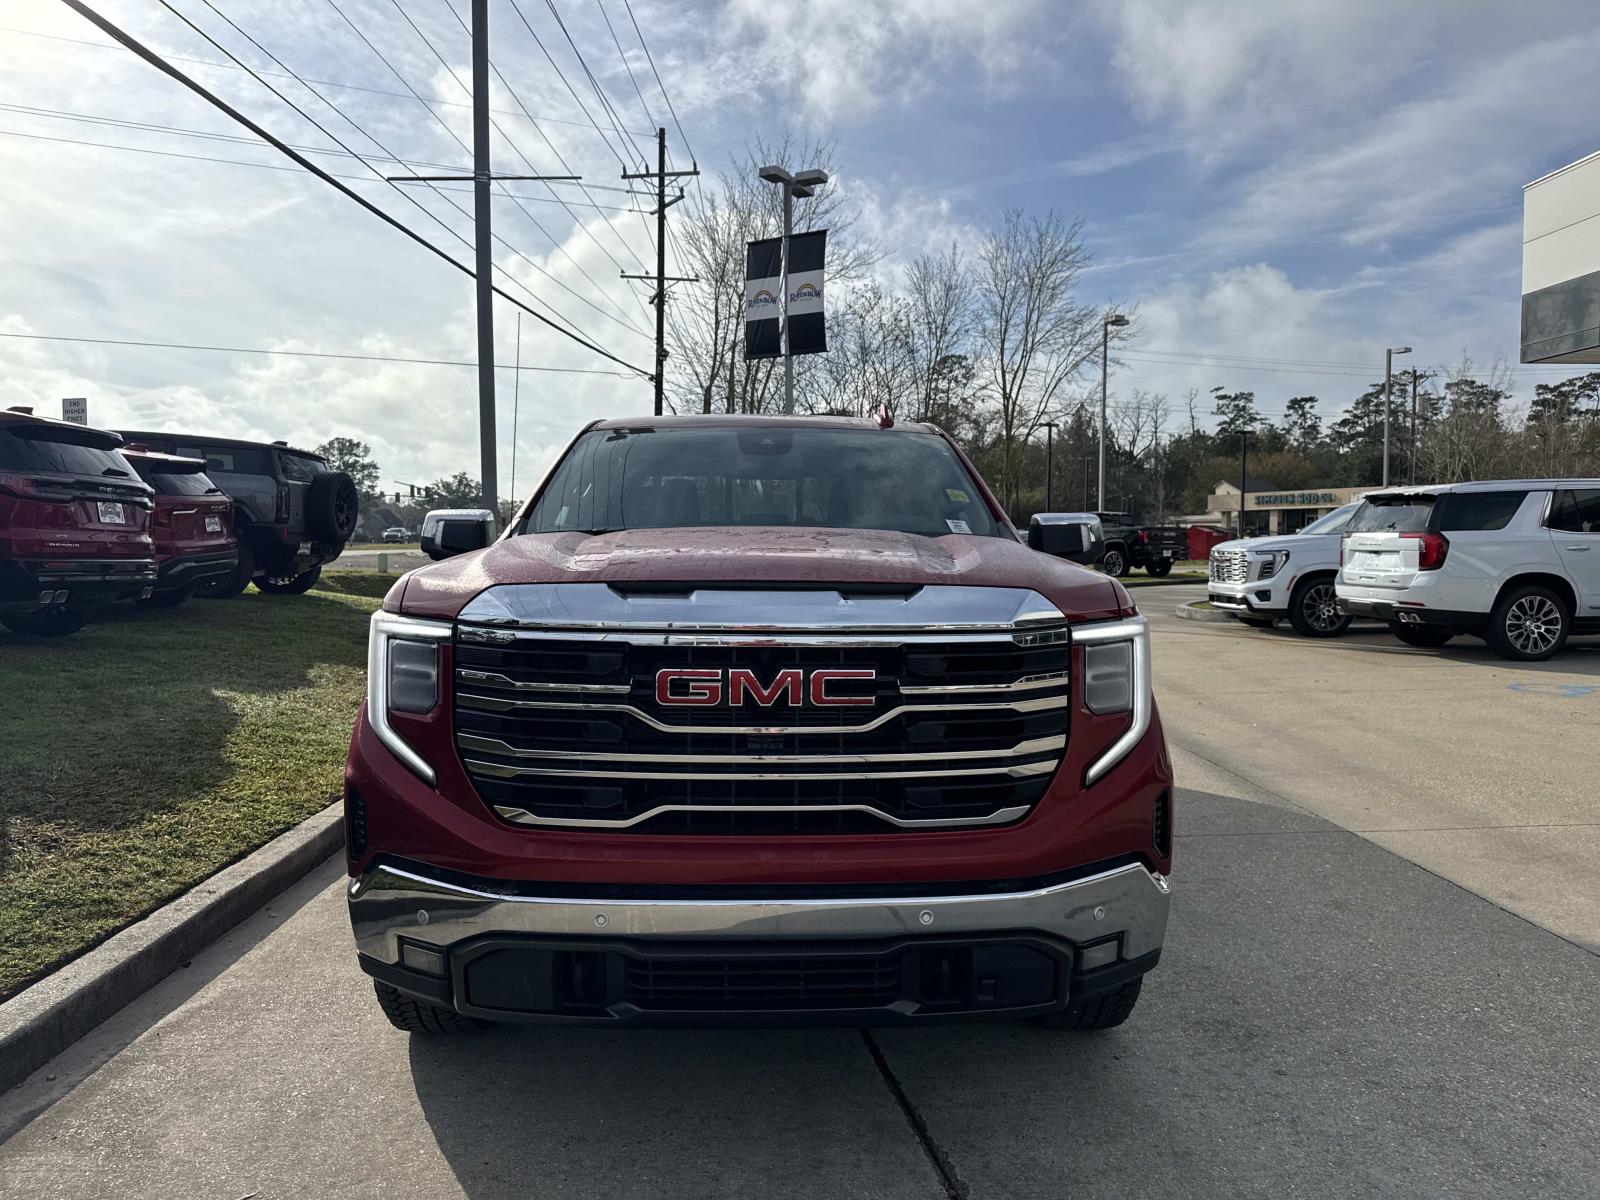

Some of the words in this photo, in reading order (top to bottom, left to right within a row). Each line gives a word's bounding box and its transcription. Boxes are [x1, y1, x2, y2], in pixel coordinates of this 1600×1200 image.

[747, 295, 778, 309] RAINBOW
[790, 288, 822, 303] RAINBOW
[69, 400, 81, 408] END
[655, 668, 877, 707] GMC
